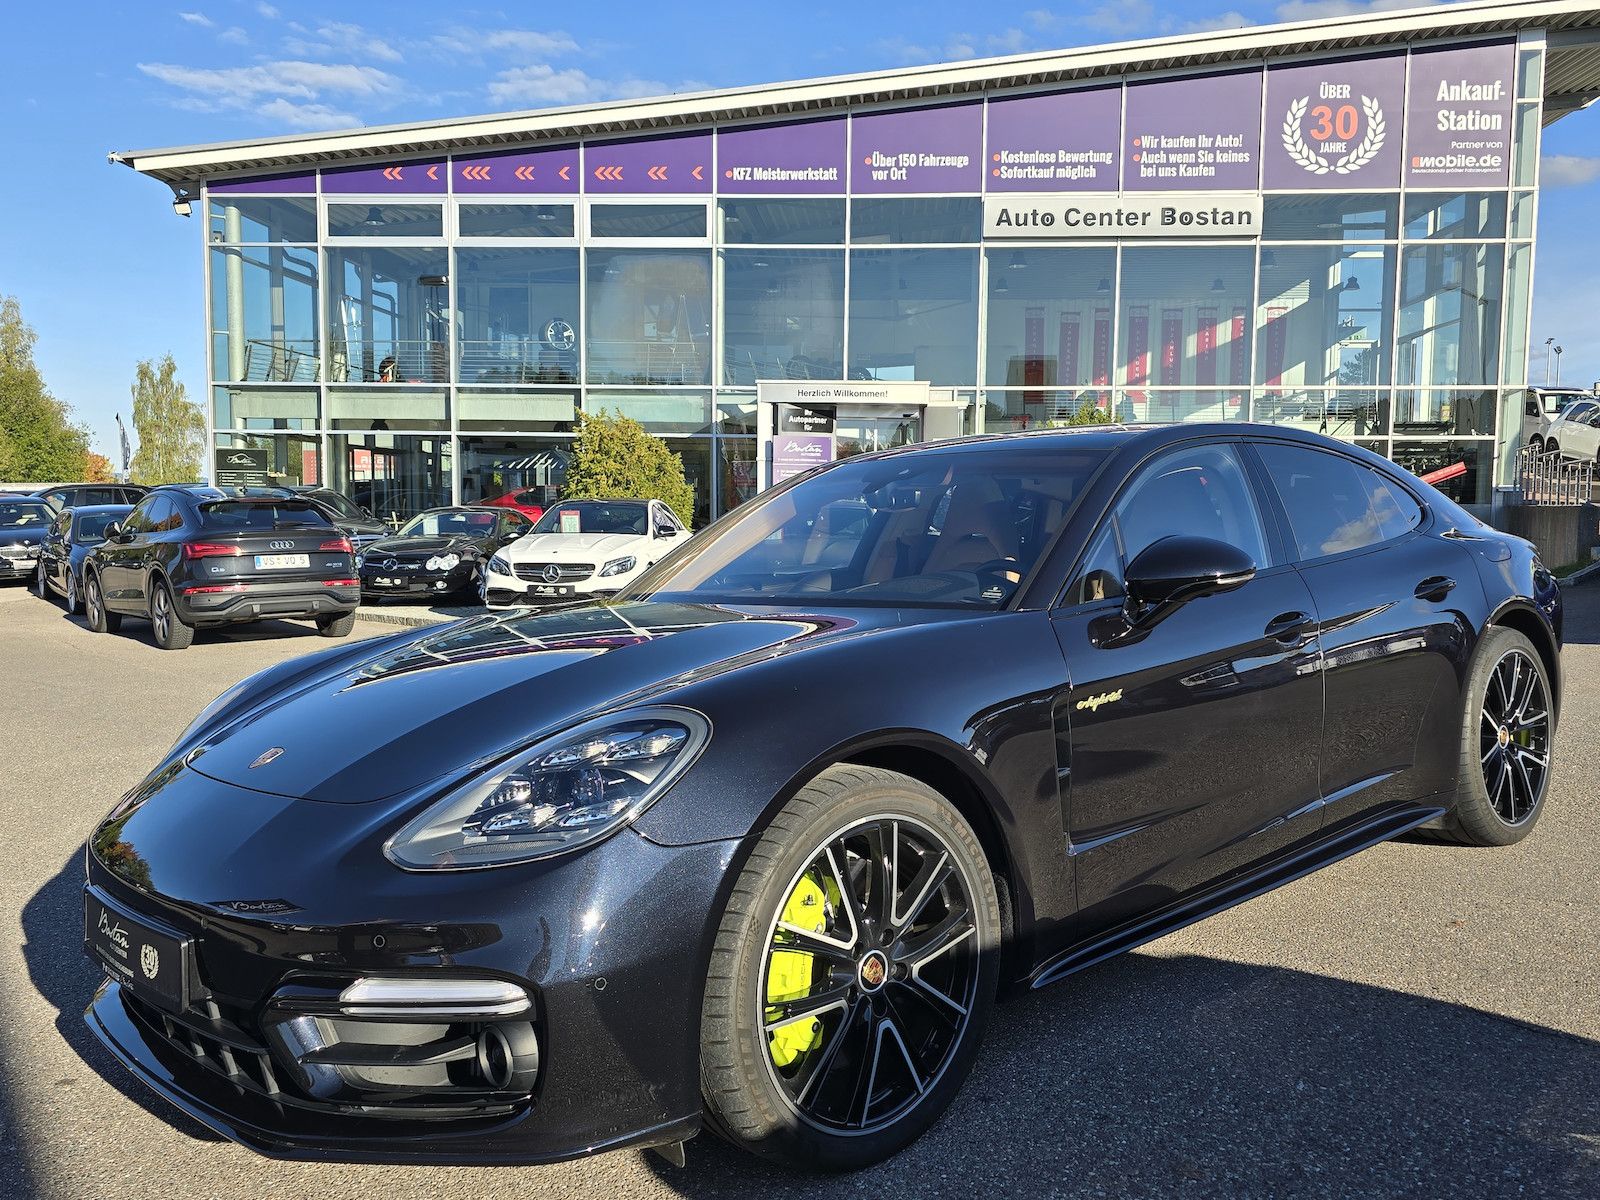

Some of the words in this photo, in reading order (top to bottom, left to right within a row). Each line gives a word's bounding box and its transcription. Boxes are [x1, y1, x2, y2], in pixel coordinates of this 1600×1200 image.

[1319, 81, 1351, 99] ÜBER
[1436, 79, 1506, 102] Ankauf-
[1309, 104, 1359, 141] 30
[1436, 109, 1503, 131] Station
[1140, 135, 1160, 148] Wir
[1160, 135, 1196, 148] kaufen
[1198, 134, 1213, 148] Ihr
[1214, 134, 1243, 148] Auto!
[1319, 141, 1347, 153] JAHRE
[1451, 141, 1484, 149] Partner
[1485, 141, 1503, 149] von
[871, 151, 897, 167] Über
[898, 153, 917, 167] 150
[918, 153, 969, 169] Fahrzeuge
[1000, 150, 1056, 164] Kostenlose
[1058, 150, 1113, 165] Bewertung
[1140, 150, 1167, 163] Auch
[1168, 152, 1196, 163] wenn
[1197, 150, 1215, 163] Sie
[1216, 150, 1250, 163] keines
[1419, 153, 1503, 168] mobile.de
[732, 167, 751, 181] KFZ
[753, 167, 838, 181] Meisterwerkstatt
[871, 169, 889, 181] vor
[889, 167, 907, 181] Ort
[1000, 165, 1055, 179] Sofortkauf
[1056, 165, 1097, 180] möglich
[1140, 165, 1157, 178] bei
[1157, 166, 1177, 177] uns
[1178, 164, 1216, 177] Kaufen
[995, 208, 1056, 227] Auto
[1064, 207, 1151, 227] Center
[1160, 206, 1253, 226] Bostan
[797, 389, 831, 398] Herzlich
[833, 389, 889, 398] Willkommen!
[788, 415, 828, 425] Autopartner
[803, 423, 813, 431] für
[783, 440, 823, 453] Bostan
[953, 821, 999, 921] MICHELIN
[97, 907, 130, 949] Bostan
